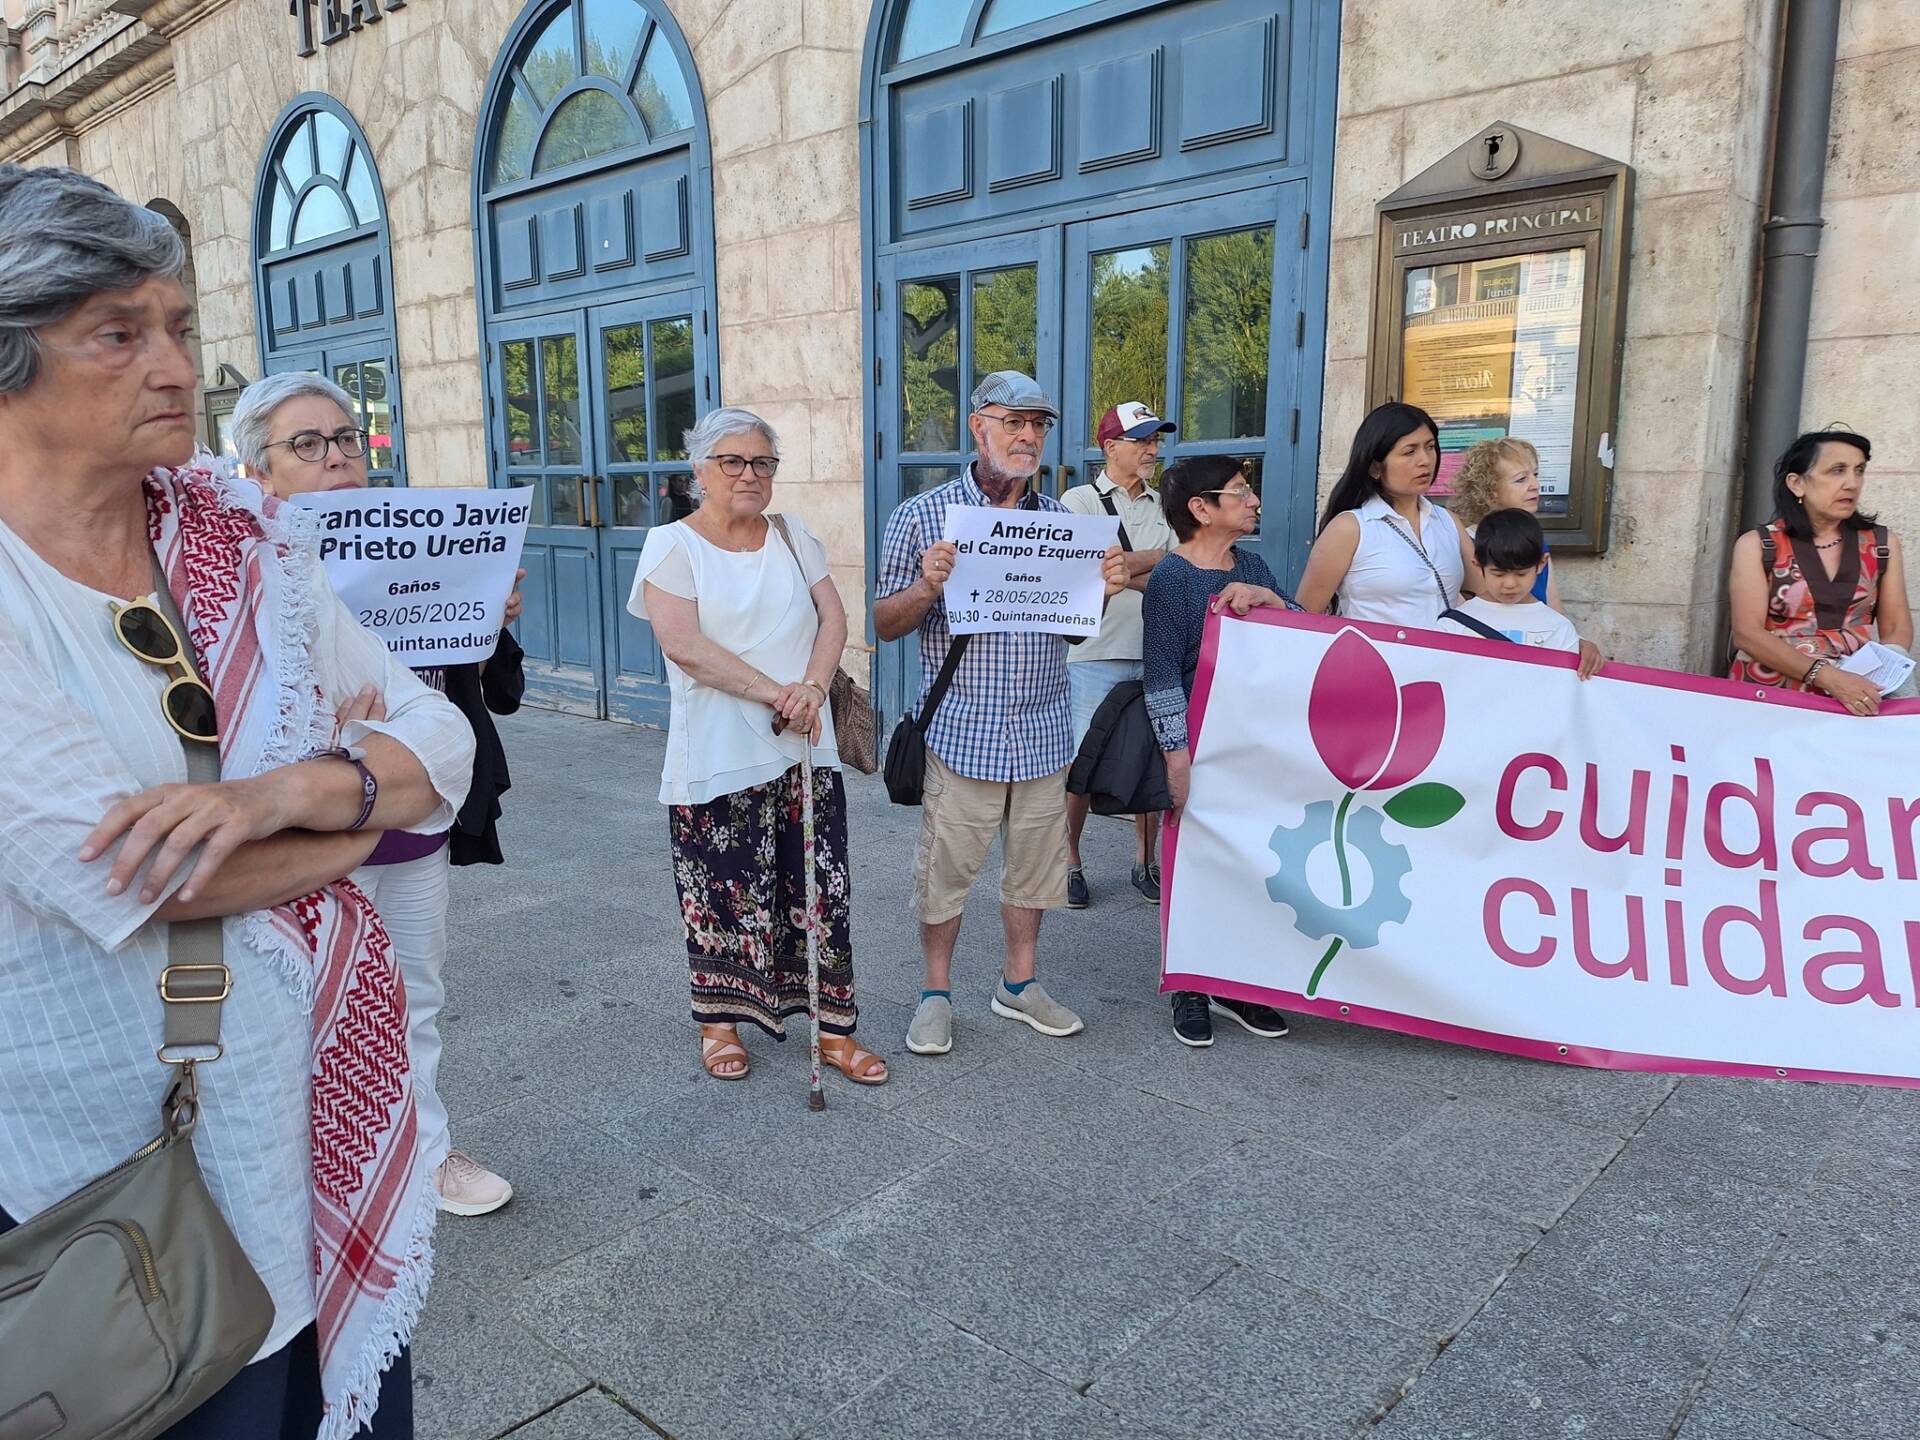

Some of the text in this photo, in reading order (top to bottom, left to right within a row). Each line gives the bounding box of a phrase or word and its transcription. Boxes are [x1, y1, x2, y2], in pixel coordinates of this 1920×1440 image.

[1400, 205, 1597, 248] TEATRO PRINCIPAL
[1487, 287, 1513, 300] Junio
[452, 501, 529, 528] Javier
[990, 520, 1074, 542] América
[319, 530, 507, 561] Prieto Ureña
[979, 541, 1034, 560] Campo
[1038, 544, 1106, 561] Ezquerro
[1005, 572, 1042, 583] 6años
[388, 580, 441, 596] 6años
[985, 589, 1069, 605] 28/05/2025
[360, 601, 486, 627] 28/05/2025
[948, 609, 980, 624] BU-30
[991, 610, 1096, 626] Quintanadueñas
